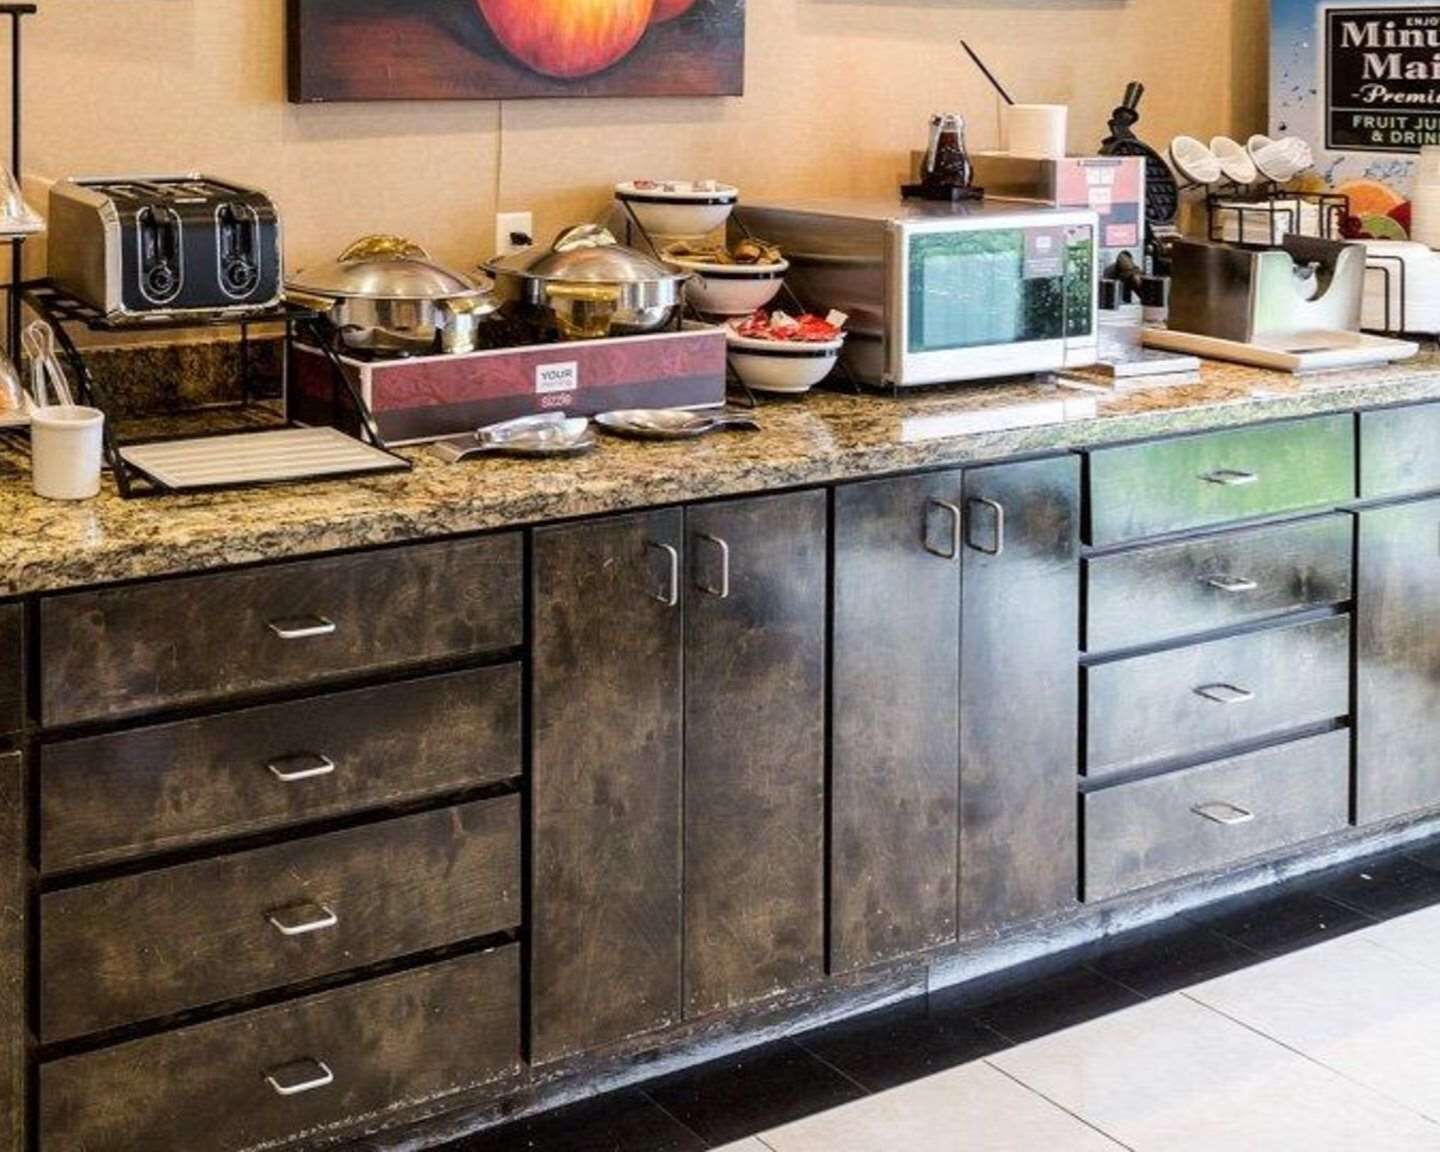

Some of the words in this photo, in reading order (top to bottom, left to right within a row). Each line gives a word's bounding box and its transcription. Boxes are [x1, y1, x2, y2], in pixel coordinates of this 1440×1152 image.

[1406, 16, 1440, 27] ENJO
[1359, 83, 1440, 104] Premi
[1352, 114, 1408, 129] FRUIT
[1371, 129, 1383, 143] &
[1391, 130, 1440, 145] DRIN
[542, 368, 574, 381] YOUR
